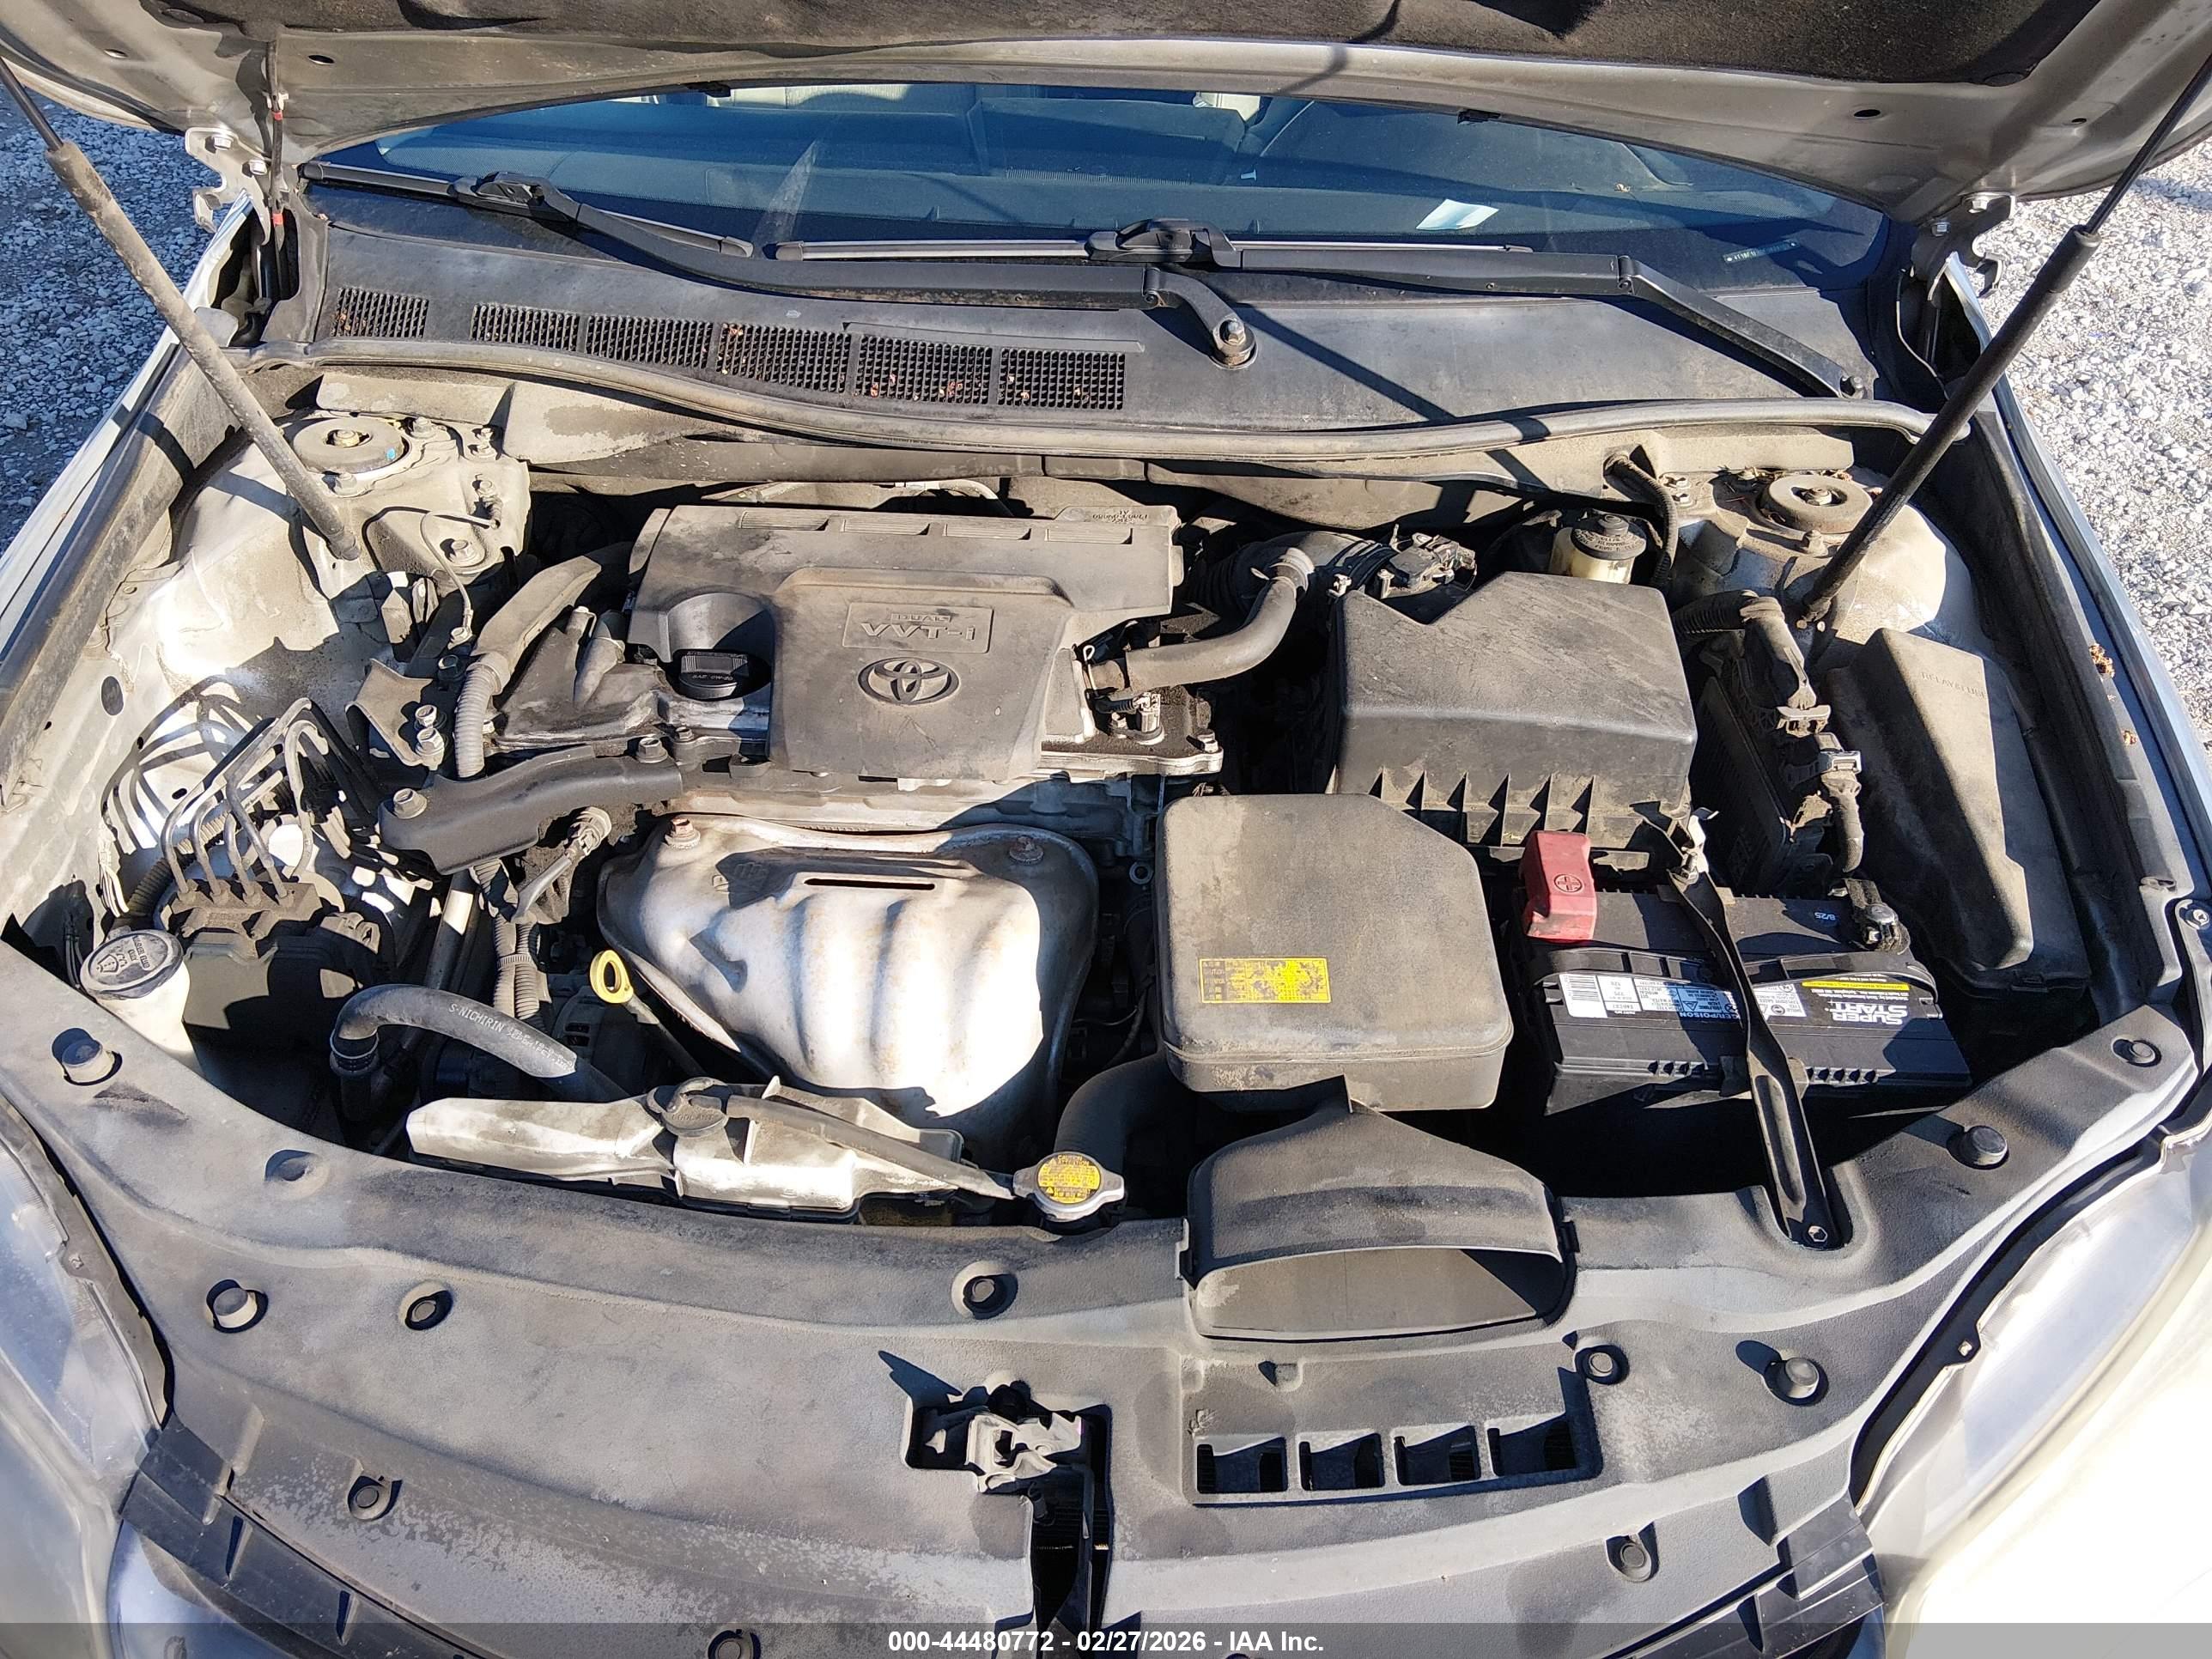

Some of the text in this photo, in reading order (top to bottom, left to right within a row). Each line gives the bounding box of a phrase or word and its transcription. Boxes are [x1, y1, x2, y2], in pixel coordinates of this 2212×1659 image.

[897, 614, 951, 623] DUAL
[861, 623, 975, 641] VVT-i
[1814, 912, 1836, 921] 8/25
[1830, 1002, 1908, 1018] START
[1832, 1012, 1903, 1025] SUPER
